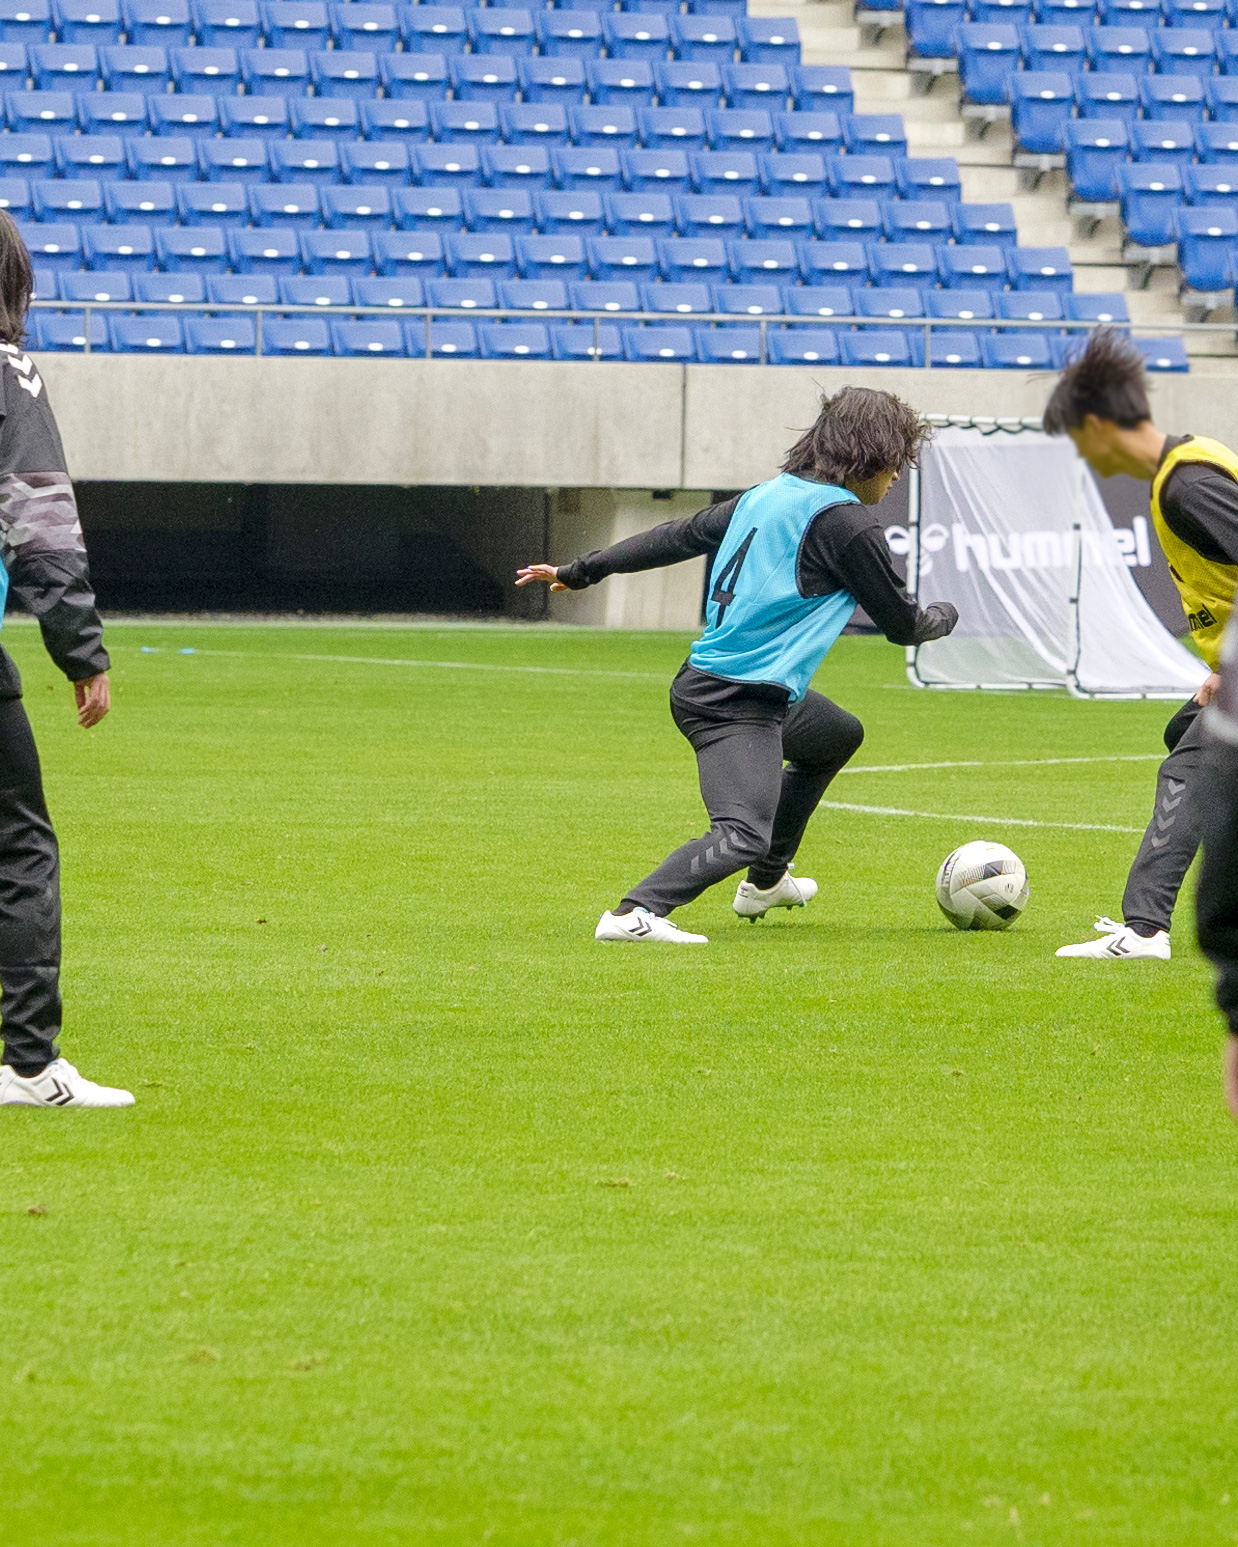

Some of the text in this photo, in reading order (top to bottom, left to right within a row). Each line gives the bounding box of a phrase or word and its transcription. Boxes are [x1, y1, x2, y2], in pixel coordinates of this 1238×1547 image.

[952, 516, 1151, 571] hummel
[711, 527, 758, 629] 4
[1188, 603, 1217, 631] mel
